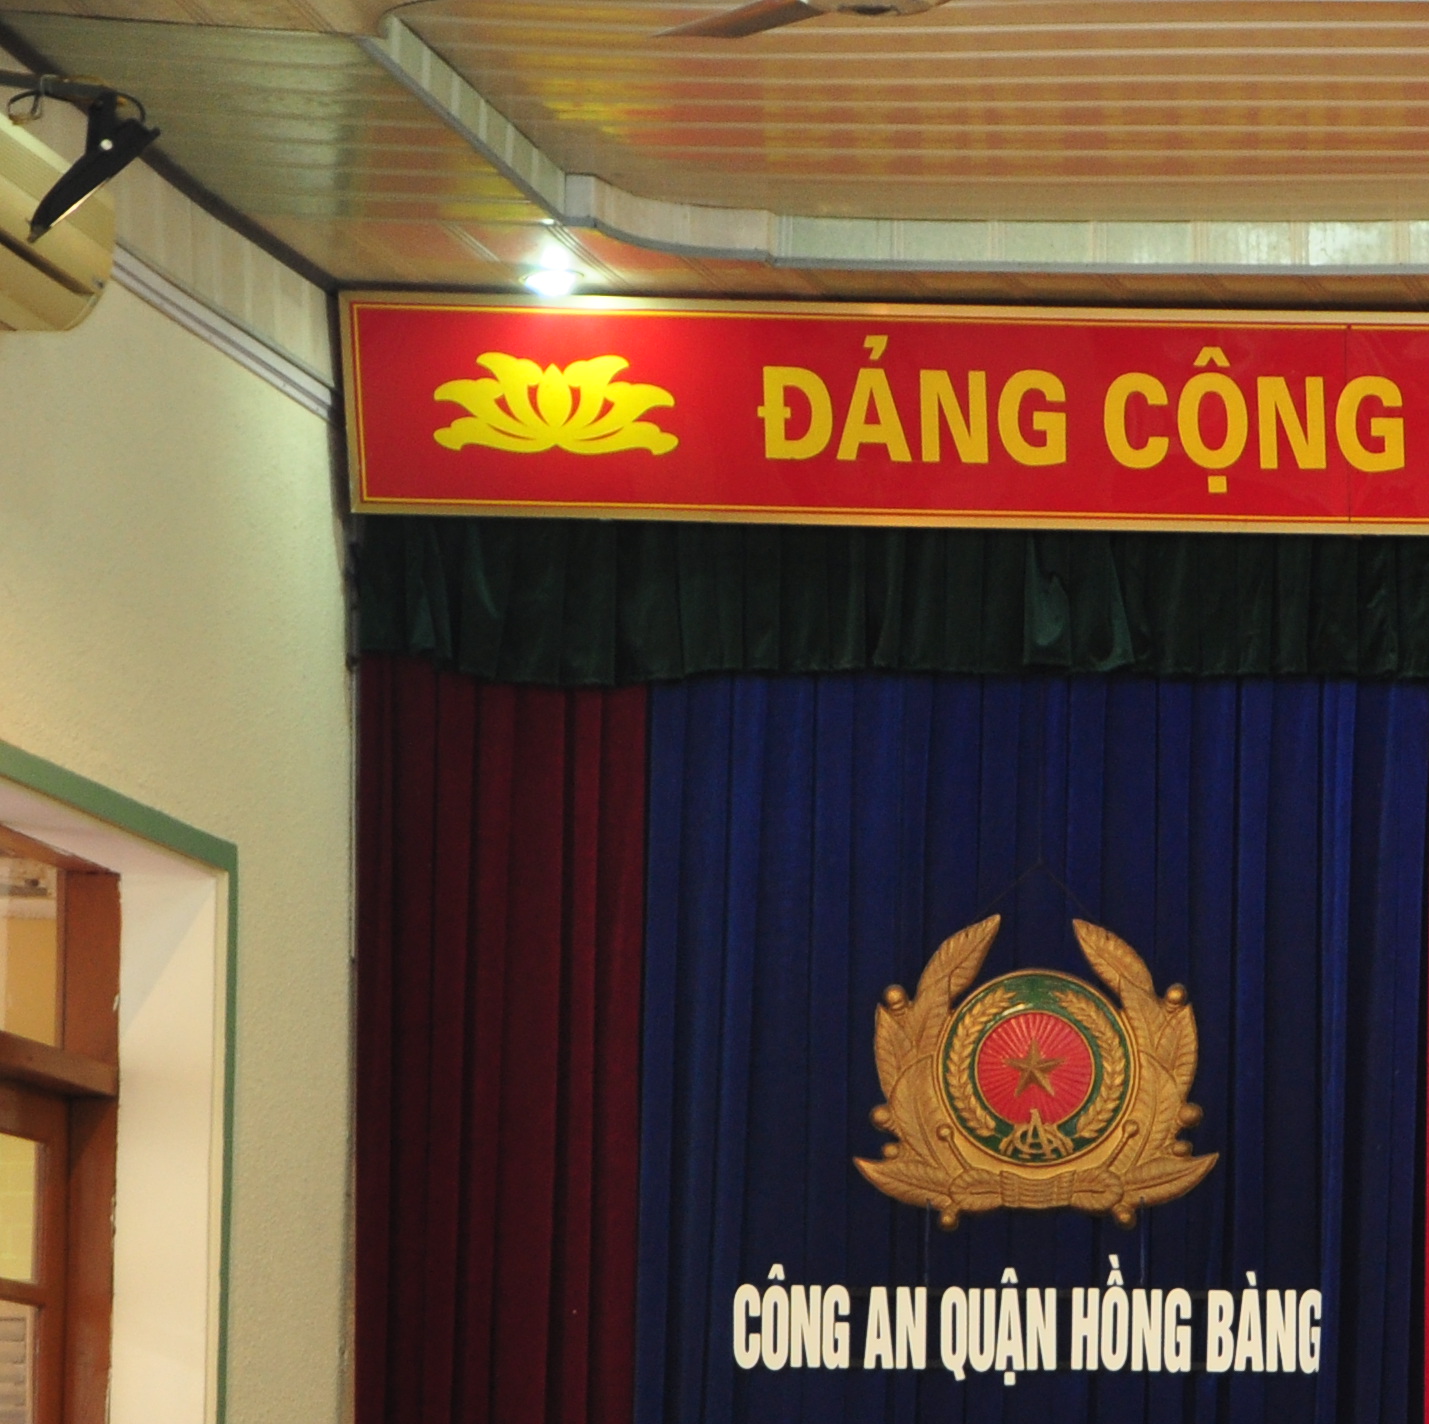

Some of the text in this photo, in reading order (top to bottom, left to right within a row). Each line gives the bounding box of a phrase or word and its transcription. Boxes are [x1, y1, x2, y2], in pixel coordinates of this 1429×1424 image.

[758, 336, 1066, 467] ĐẢNG
[1104, 347, 1404, 494] CỘNG
[733, 1254, 1322, 1385] CÔNG AN QUẬN HỒNG BÀNG
